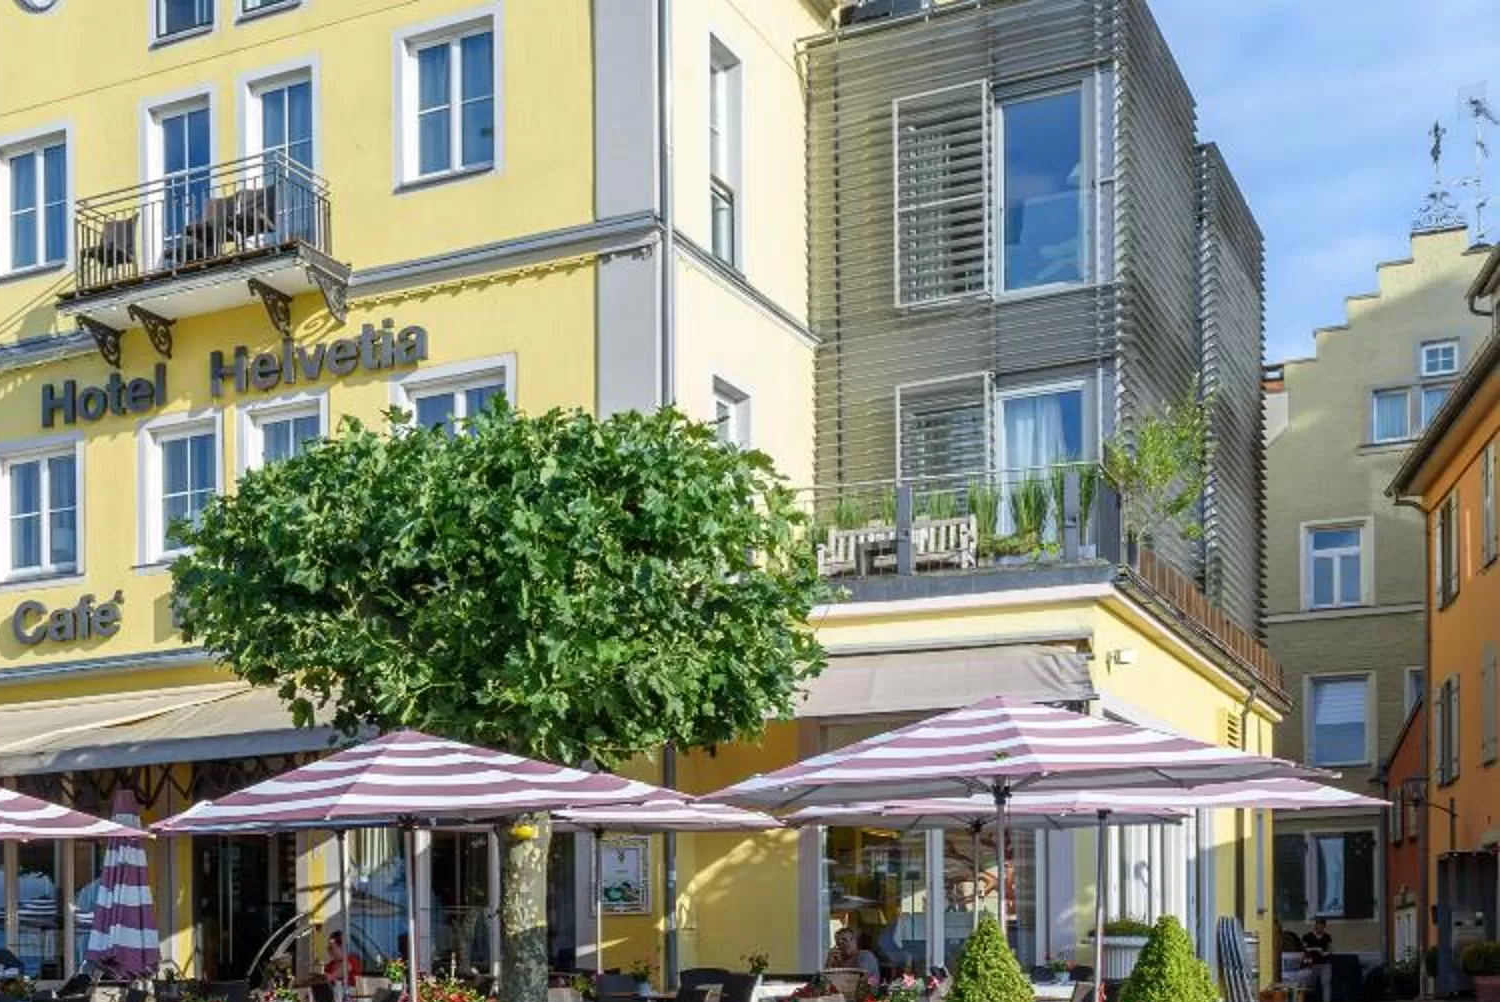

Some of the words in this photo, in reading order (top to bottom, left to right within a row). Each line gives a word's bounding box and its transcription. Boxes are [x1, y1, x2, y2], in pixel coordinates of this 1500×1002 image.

[41, 362, 168, 428] Hotel
[210, 319, 429, 398] Helvetia
[12, 589, 125, 645] Café
